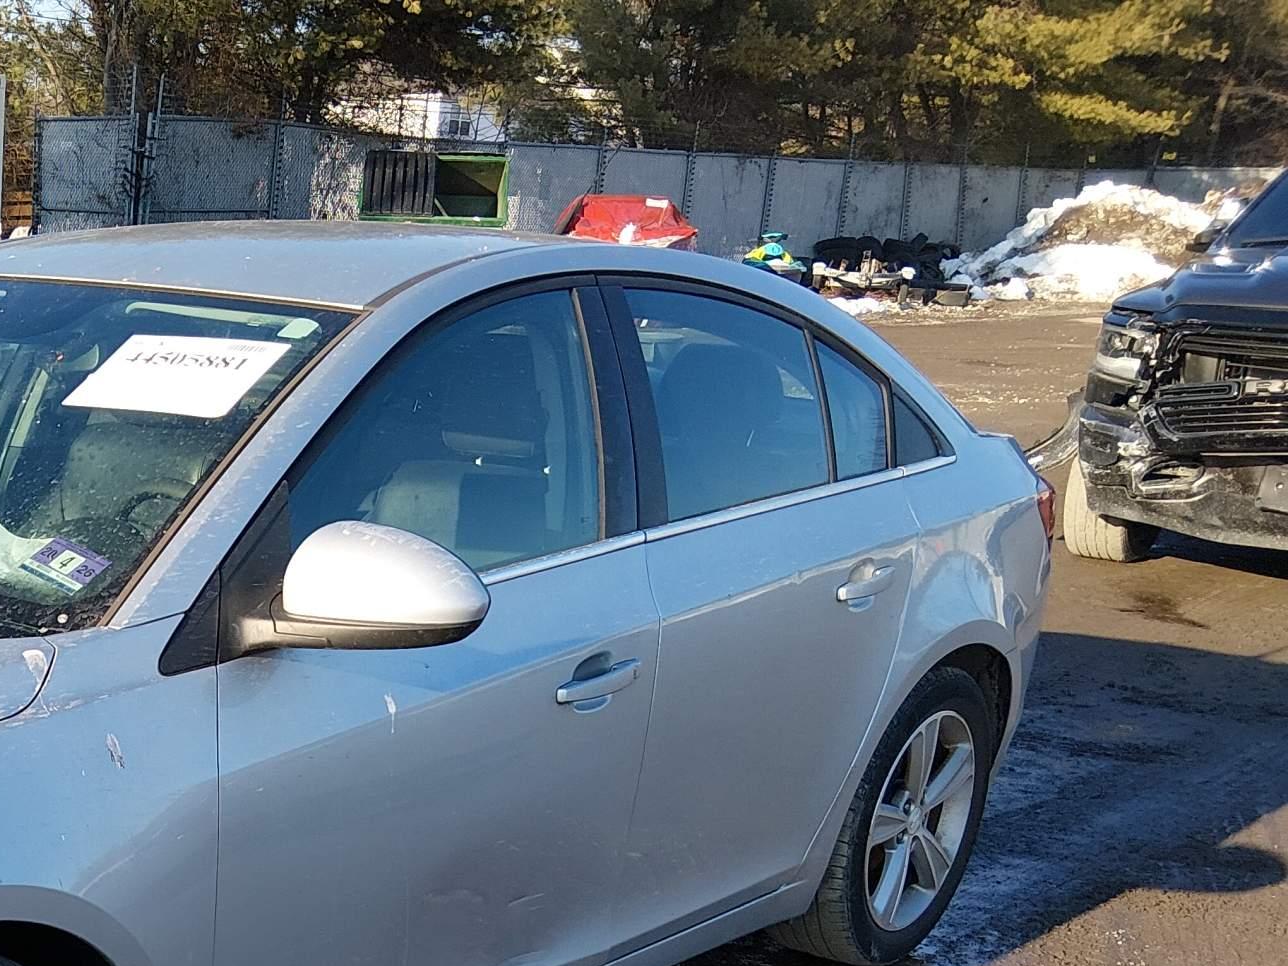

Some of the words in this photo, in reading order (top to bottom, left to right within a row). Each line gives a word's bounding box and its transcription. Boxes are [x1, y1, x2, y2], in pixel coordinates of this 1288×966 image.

[125, 350, 249, 371] 44505881
[40, 546, 58, 560] 20
[58, 556, 76, 569] 4
[75, 564, 96, 578] 26
